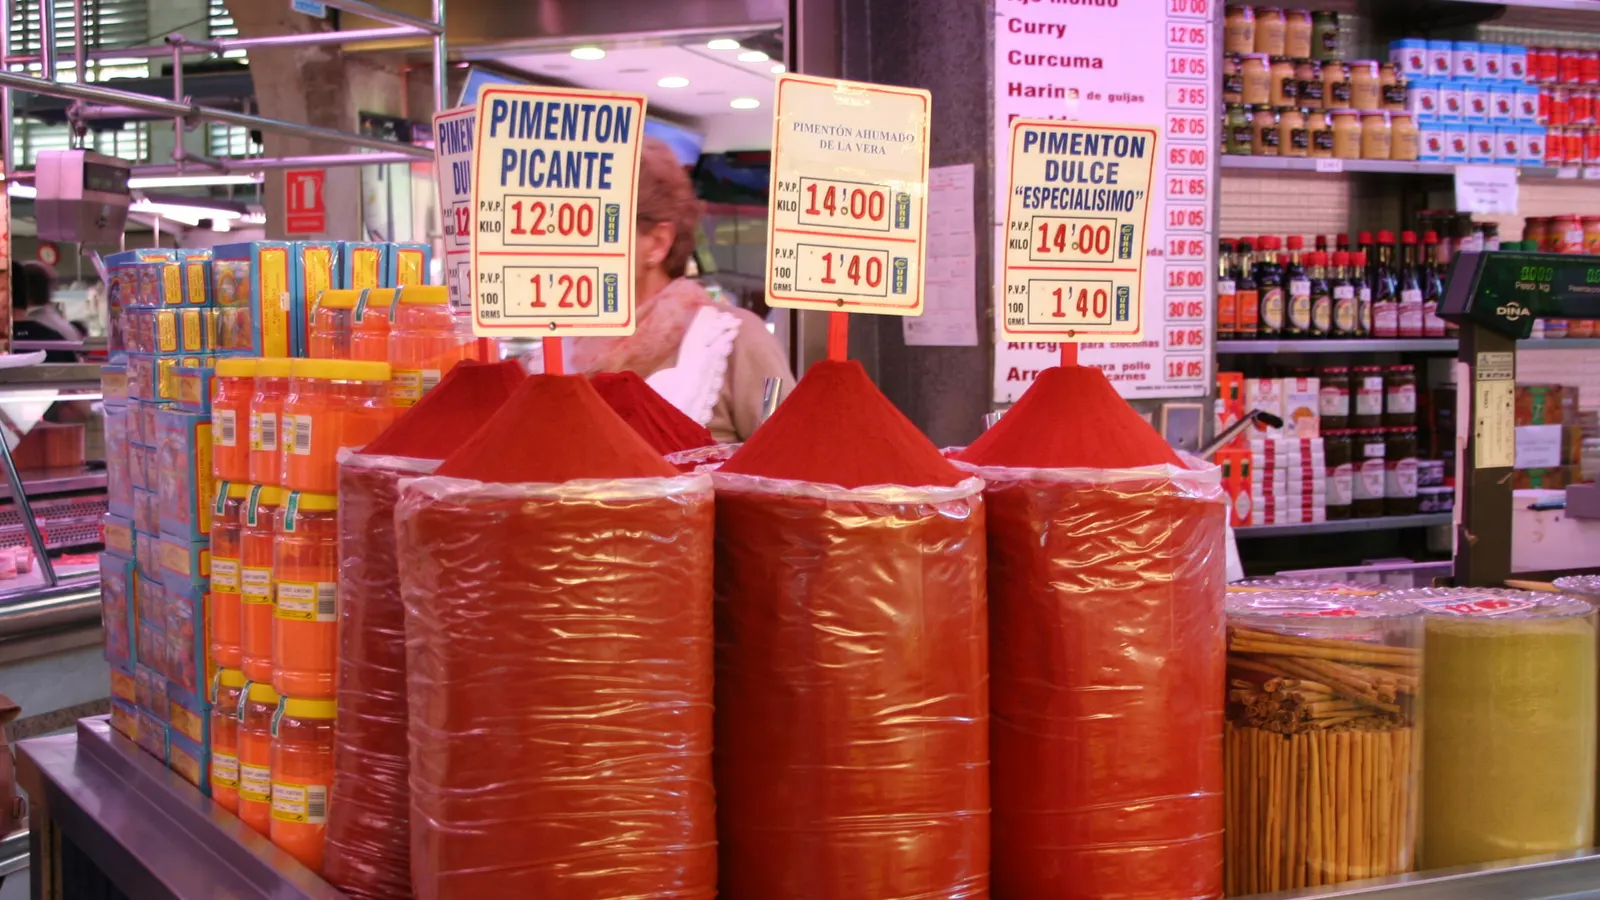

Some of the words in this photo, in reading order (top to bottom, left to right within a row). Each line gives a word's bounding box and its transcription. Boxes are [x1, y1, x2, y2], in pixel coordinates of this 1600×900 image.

[1008, 18, 1066, 38] Curry
[1170, 27, 1205, 43] 12'05
[1008, 50, 1103, 69] Curcuma
[1008, 82, 1079, 99] Harina
[1087, 91, 1101, 101] de
[1108, 92, 1144, 103] guijas
[490, 99, 632, 143] PIMENTON
[439, 117, 476, 156] PIMEN
[793, 121, 853, 137] PIMENTÓN
[855, 129, 915, 144] AHUMADO
[819, 139, 835, 151] DE
[837, 141, 852, 152] LA
[855, 143, 886, 155] VERA
[1023, 131, 1146, 158] PIMENTON
[500, 149, 614, 190] PICANTE
[1045, 160, 1119, 184] DULCE
[778, 182, 799, 193] P.V.P.
[480, 201, 503, 212] P.V.P.
[777, 200, 797, 212] KILO
[805, 183, 885, 222] 14'00
[455, 207, 470, 237] 12
[510, 200, 594, 237] 12'00
[479, 221, 501, 233] KILO
[1011, 221, 1031, 232] P.V.P.
[1009, 239, 1029, 250] KILO
[1036, 222, 1111, 255] 14'00
[775, 248, 796, 260] P.V.P.
[774, 266, 791, 278] 100
[821, 252, 883, 288] 1'40
[480, 272, 503, 283] P.V.P.
[530, 273, 593, 308] 1'20
[773, 283, 792, 292] GRMS
[1008, 285, 1028, 295] P.V.P.
[1540, 281, 1551, 292] kg
[480, 293, 498, 305] 100
[1052, 286, 1107, 318] 1'40
[480, 310, 500, 319] GRMS
[1008, 303, 1024, 313] 100
[1496, 306, 1531, 316] DINA
[1007, 317, 1025, 326] GRMS
[1122, 361, 1151, 372] pollo
